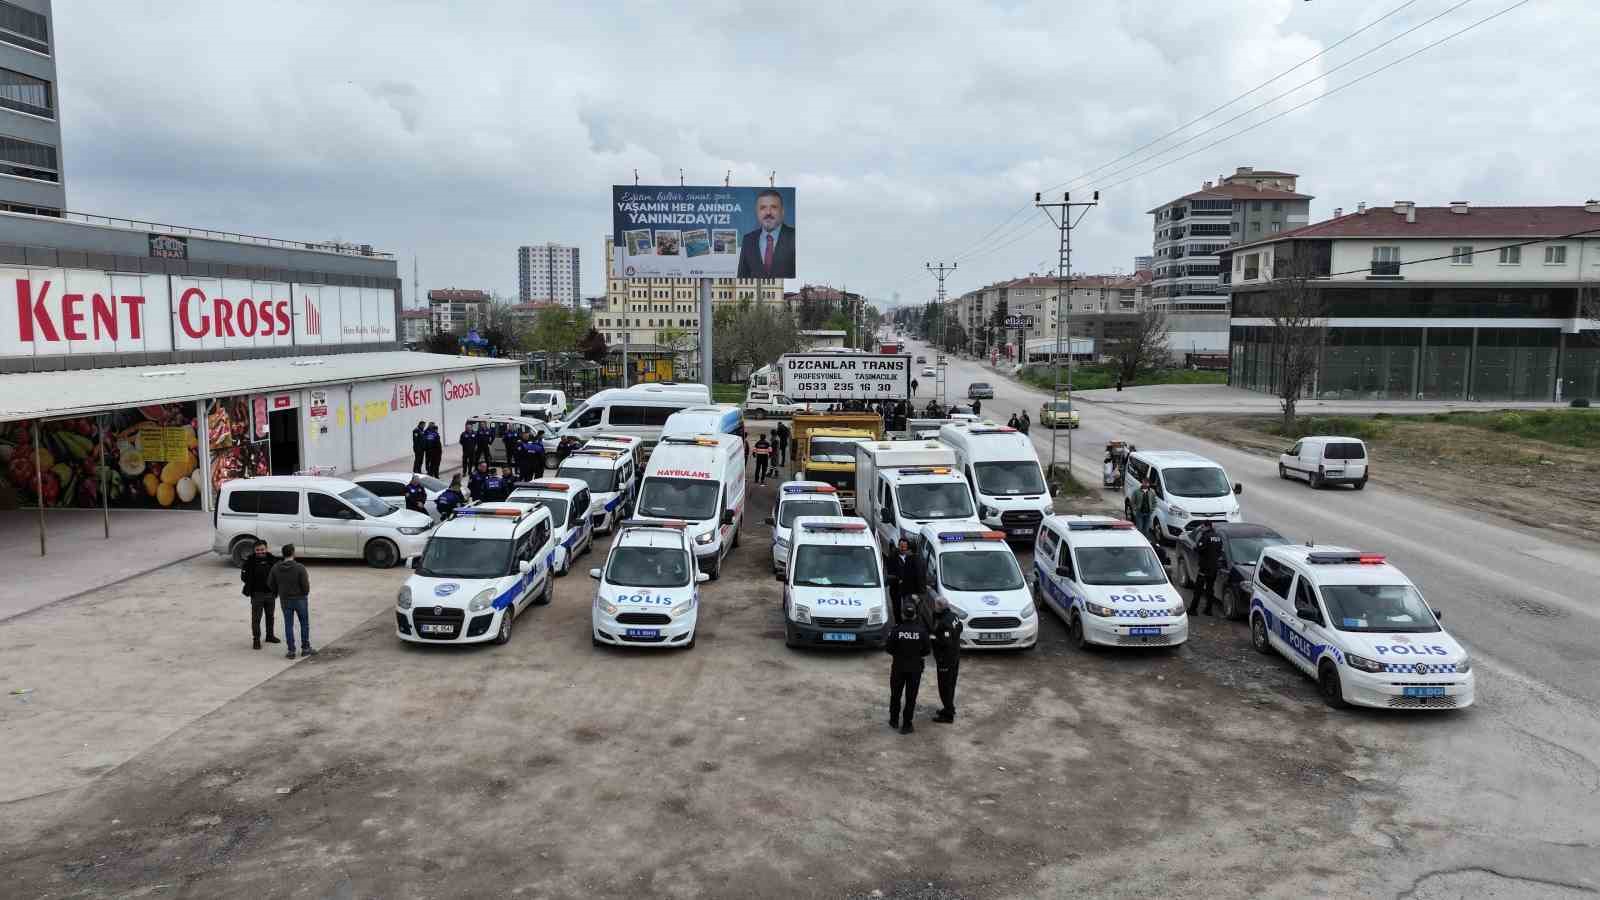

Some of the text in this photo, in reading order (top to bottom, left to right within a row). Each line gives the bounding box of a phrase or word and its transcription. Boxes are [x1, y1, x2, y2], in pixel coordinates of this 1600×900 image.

[617, 202, 742, 214] YAŞAMIN HER ANINDA
[16, 279, 291, 342] KENT GROSS
[862, 361, 904, 370] TRANS
[793, 372, 841, 380] PROFESYONEL
[798, 382, 891, 392] 0533 235 16 30
[404, 383, 433, 409] KENT
[443, 378, 475, 401] GROSS
